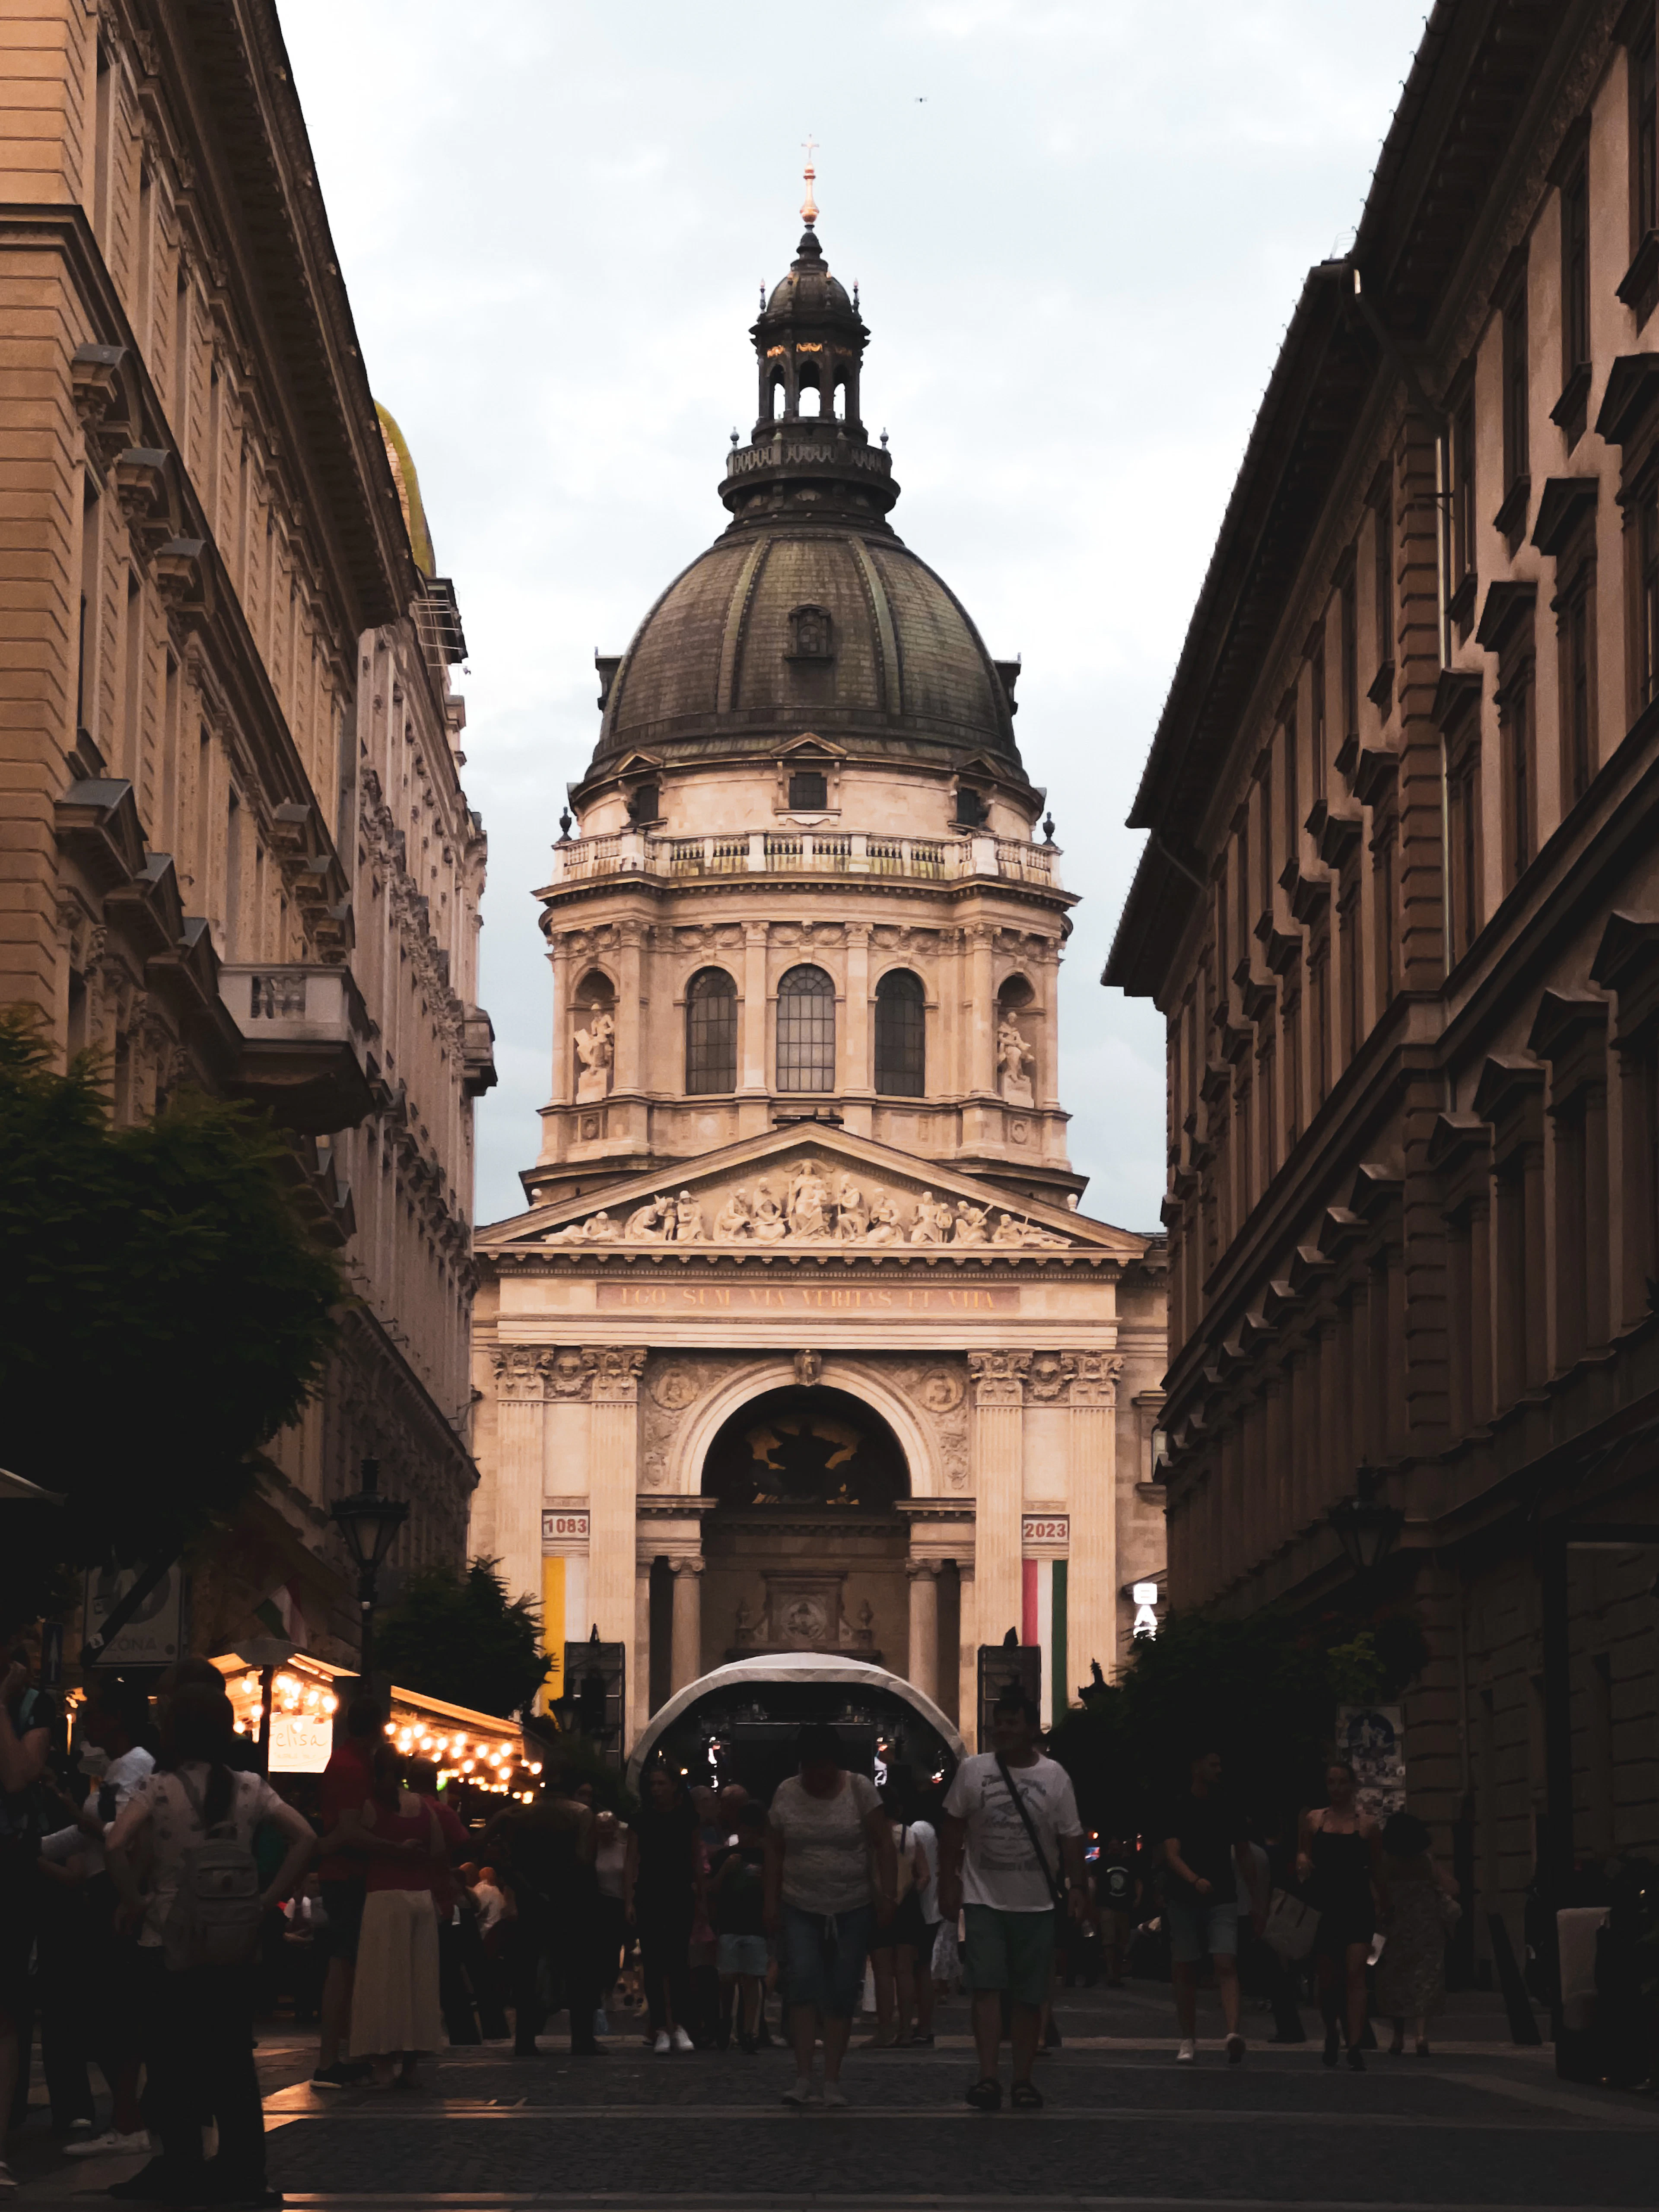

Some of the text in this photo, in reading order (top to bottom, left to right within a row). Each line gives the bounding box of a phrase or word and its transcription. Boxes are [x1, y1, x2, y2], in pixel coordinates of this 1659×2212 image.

[682, 1288, 731, 1306] SUM
[748, 1289, 786, 1307] VIA
[947, 1290, 996, 1309] VITA
[544, 1518, 586, 1533] 1083
[1023, 1523, 1066, 1538] 2023
